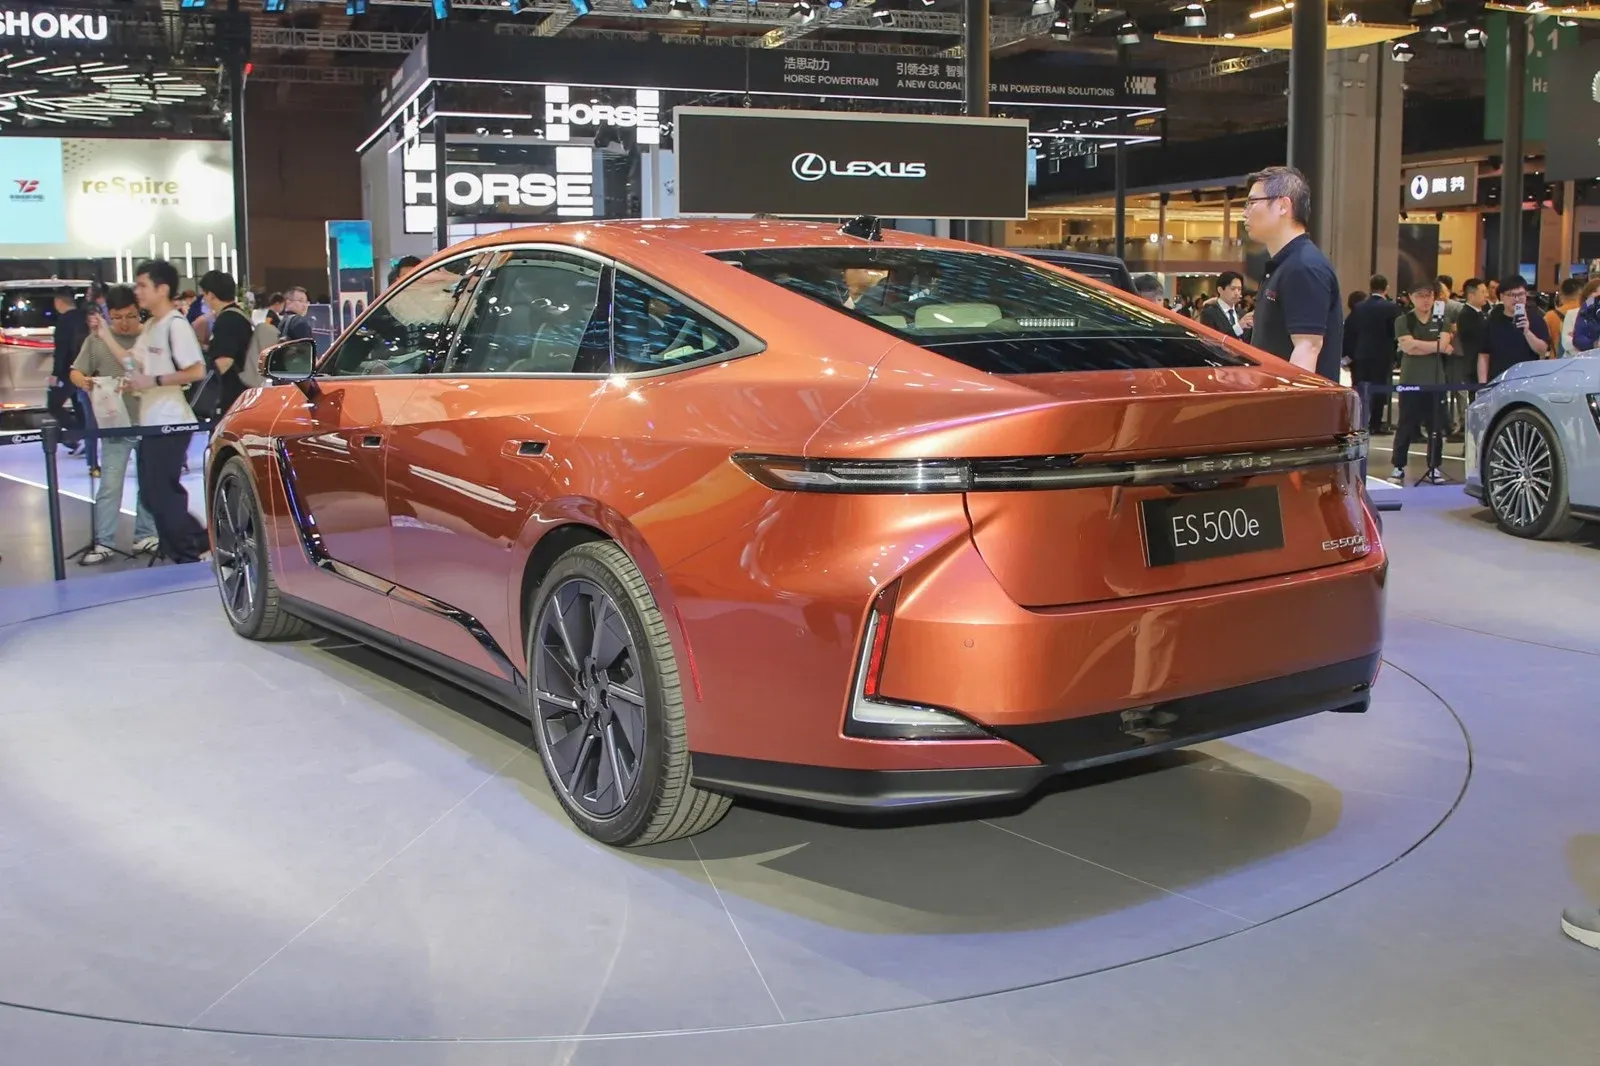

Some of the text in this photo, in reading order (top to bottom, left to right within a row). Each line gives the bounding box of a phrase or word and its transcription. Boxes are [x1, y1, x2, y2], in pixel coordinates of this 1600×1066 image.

[0, 11, 108, 40] HOKU
[784, 57, 829, 71] 浩思动力
[897, 63, 939, 77] 引领全球
[784, 74, 879, 87] HORSE POWERTRAIN
[897, 80, 905, 88] A
[905, 80, 927, 89] NEW
[928, 81, 963, 90] GLOBAL
[1000, 84, 1009, 92] IN
[1010, 84, 1066, 94] POWERTRAIN
[1068, 87, 1115, 97] SOLUTIONS
[546, 103, 660, 127] HORSE
[830, 160, 927, 178] LEXUS
[82, 176, 179, 198] reSpire
[404, 171, 593, 206] HORSE
[1182, 456, 1272, 474] LEXUS
